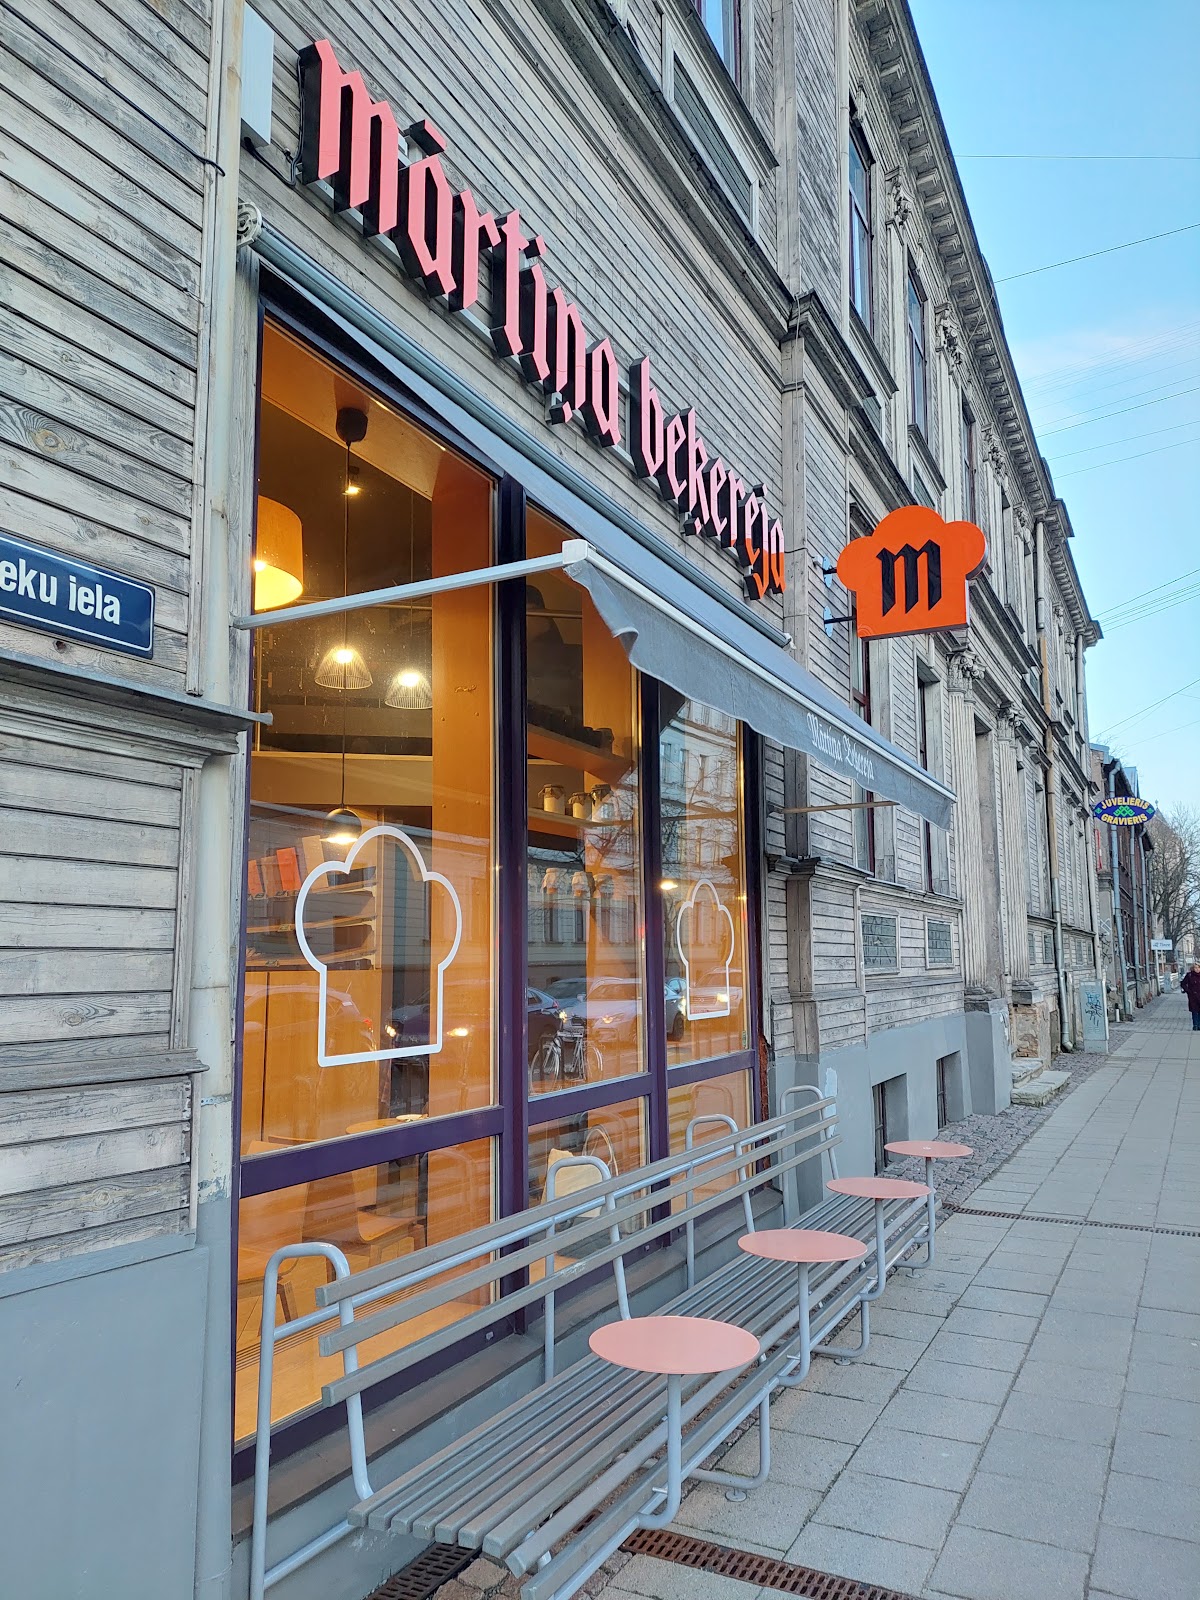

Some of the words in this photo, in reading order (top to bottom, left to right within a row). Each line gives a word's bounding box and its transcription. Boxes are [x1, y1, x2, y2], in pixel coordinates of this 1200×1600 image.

[876, 539, 942, 618] m
[68, 575, 121, 626] iela
[1101, 797, 1150, 810] JUVELIERIS
[1101, 813, 1148, 826] GRAVIERIS
